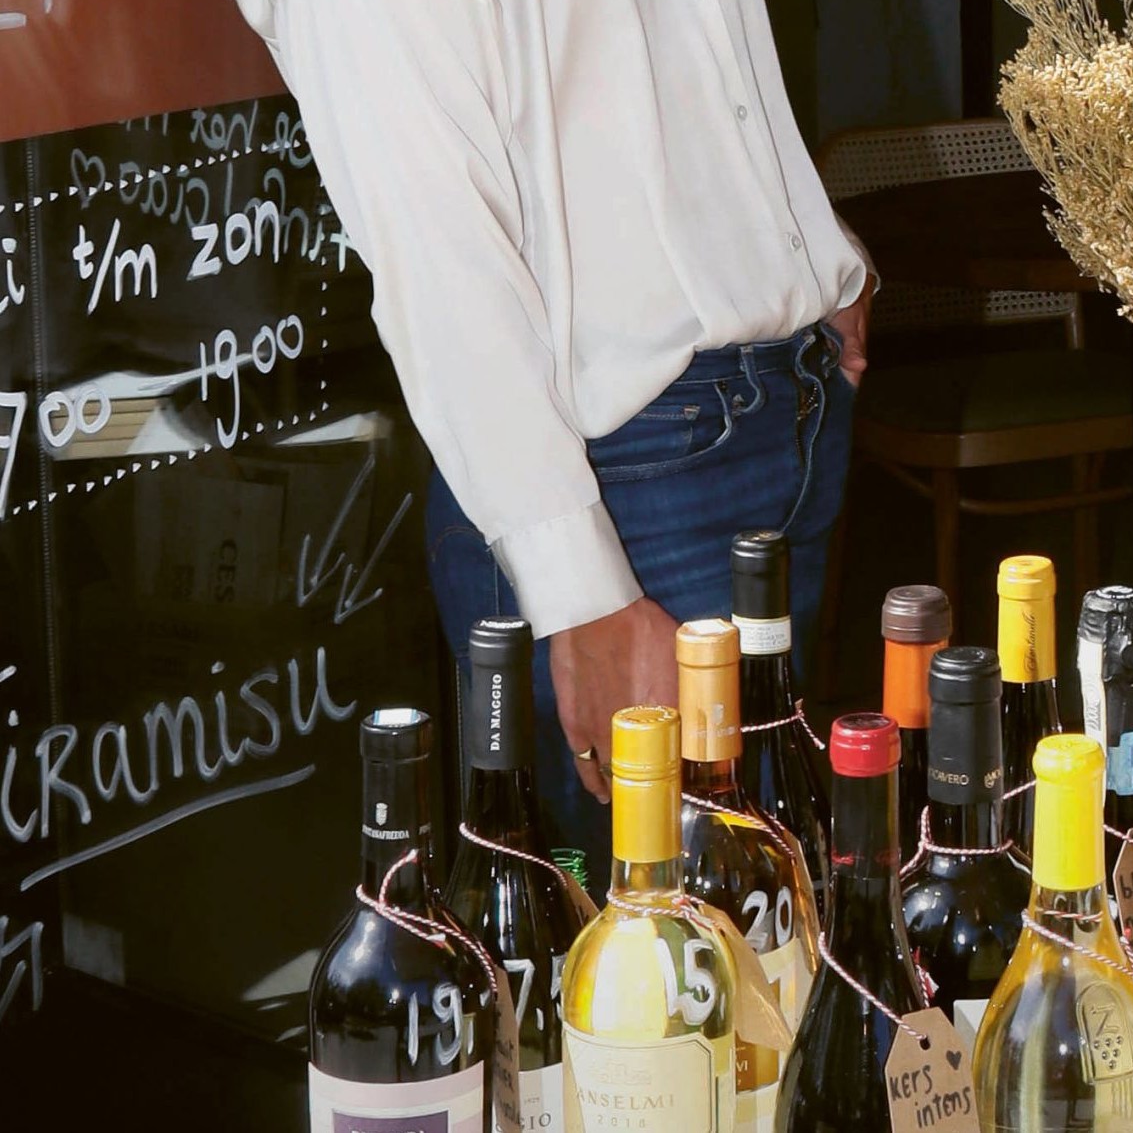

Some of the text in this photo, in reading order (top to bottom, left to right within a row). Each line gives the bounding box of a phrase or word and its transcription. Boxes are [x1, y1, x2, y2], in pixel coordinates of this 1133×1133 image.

[73, 217, 158, 317] t/m
[490, 673, 502, 751] DA MAGGIO
[741, 885, 794, 953] 20
[913, 1085, 972, 1129] intens
